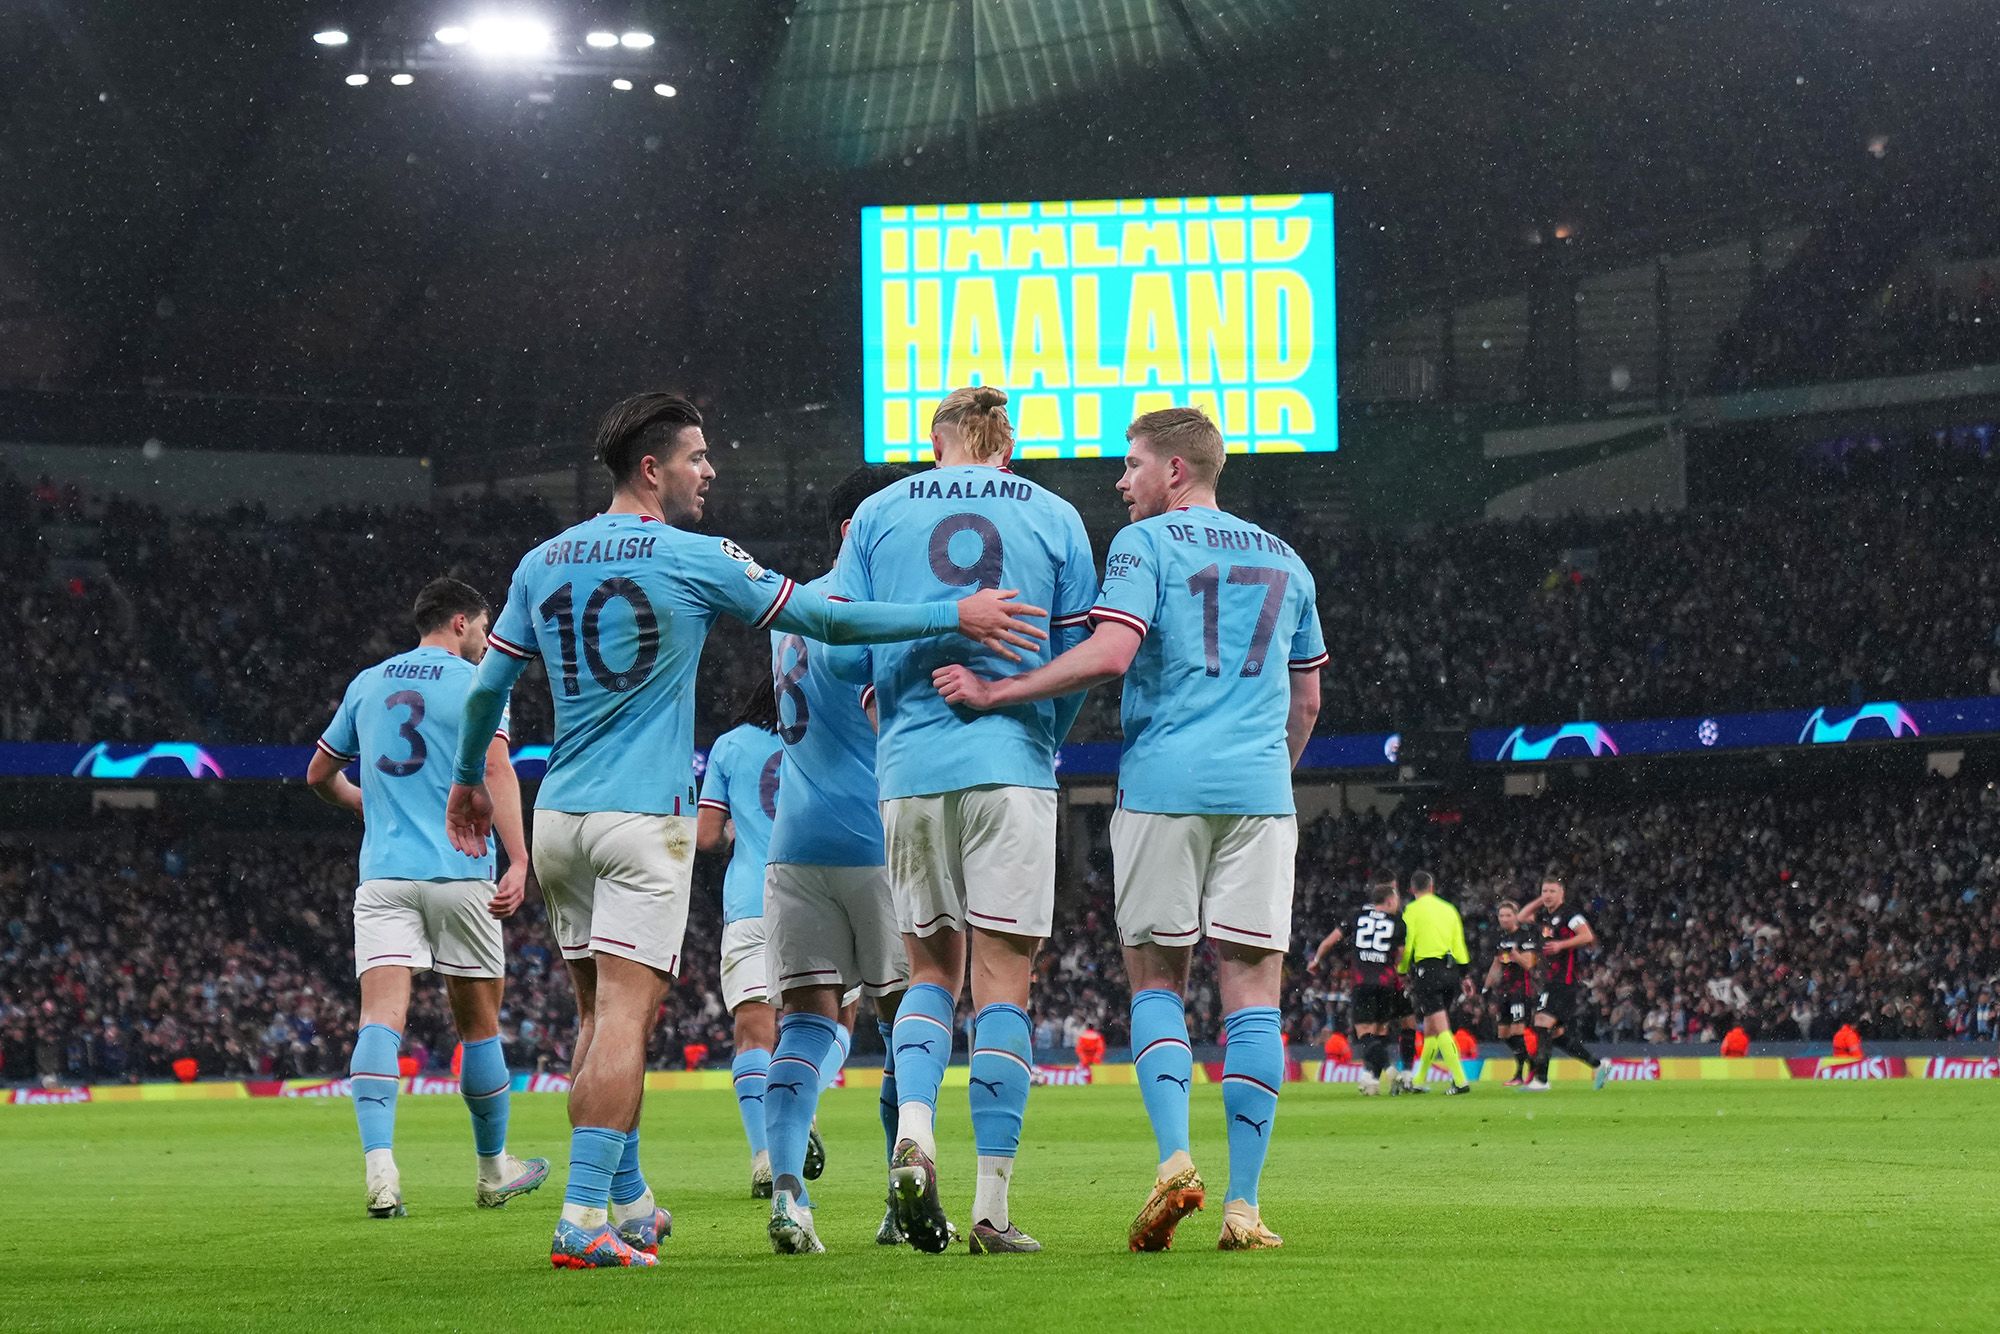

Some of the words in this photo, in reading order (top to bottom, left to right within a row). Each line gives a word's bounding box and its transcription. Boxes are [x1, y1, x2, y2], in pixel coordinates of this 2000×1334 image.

[881, 268, 1314, 392] HAALAND
[909, 479, 1033, 502] HAALAND
[544, 537, 657, 566] GREALISH
[928, 512, 1004, 591] 9
[1166, 524, 1198, 545] DE
[1203, 527, 1293, 558] BRUYNE
[539, 576, 659, 696] 10
[1185, 563, 1290, 678] 17
[383, 660, 443, 681] RÚBEN
[774, 633, 810, 745] 8
[375, 690, 427, 777] 3
[1355, 915, 1395, 951] 22
